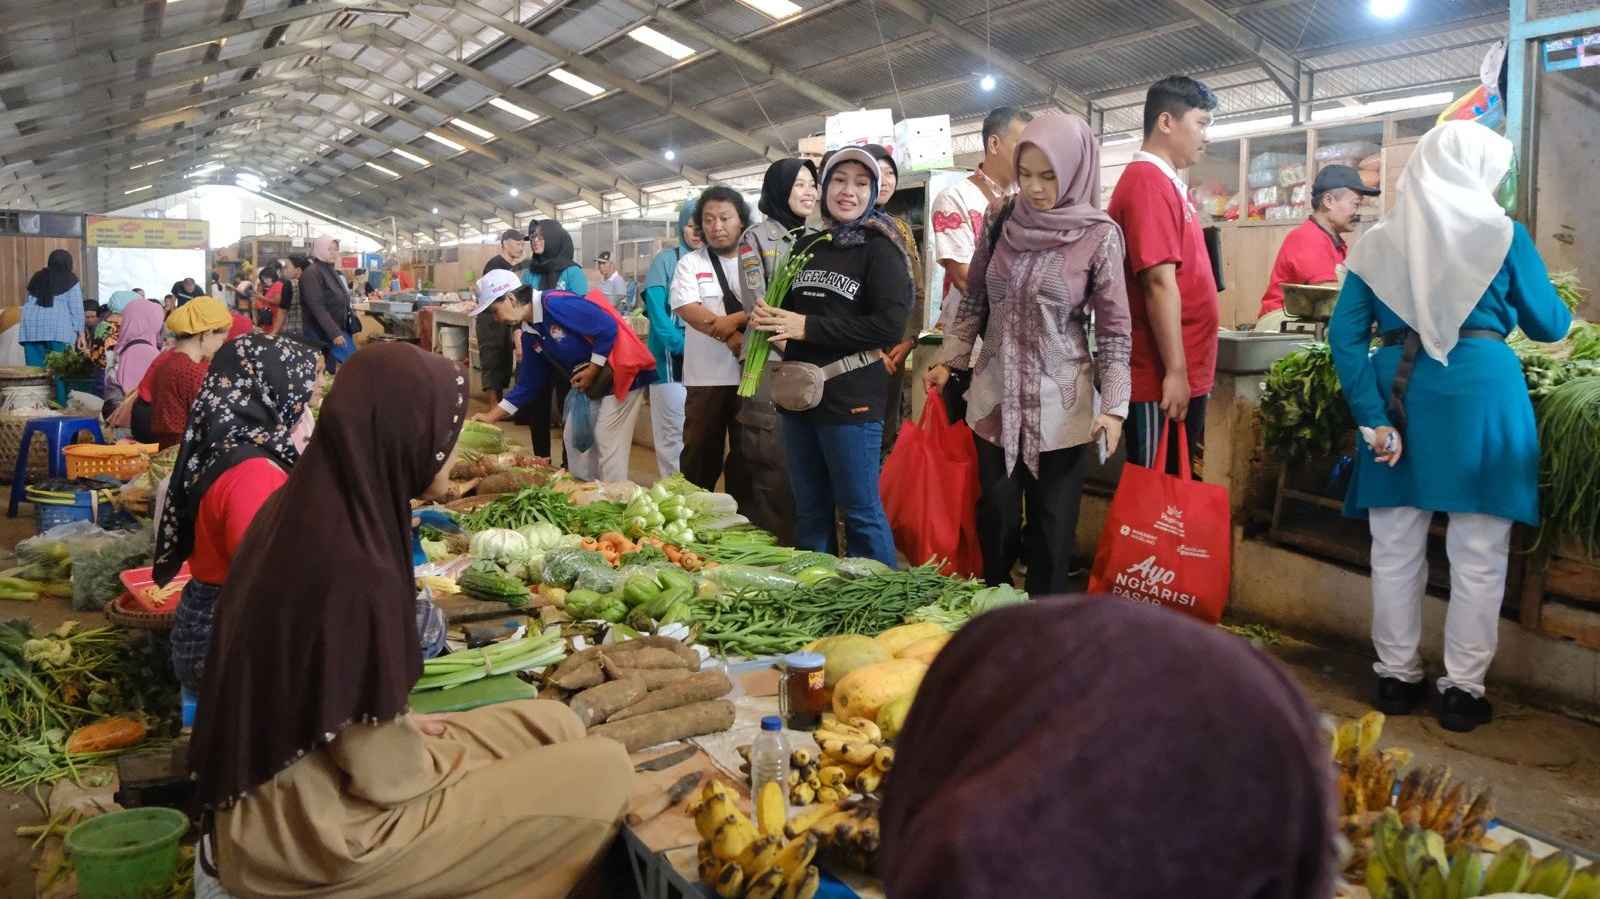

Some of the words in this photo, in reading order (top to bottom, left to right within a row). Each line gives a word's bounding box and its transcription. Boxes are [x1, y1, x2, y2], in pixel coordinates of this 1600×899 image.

[792, 269, 860, 297] AGELANG
[1126, 555, 1175, 586] Ayo
[1115, 572, 1196, 606] NGLARISI
